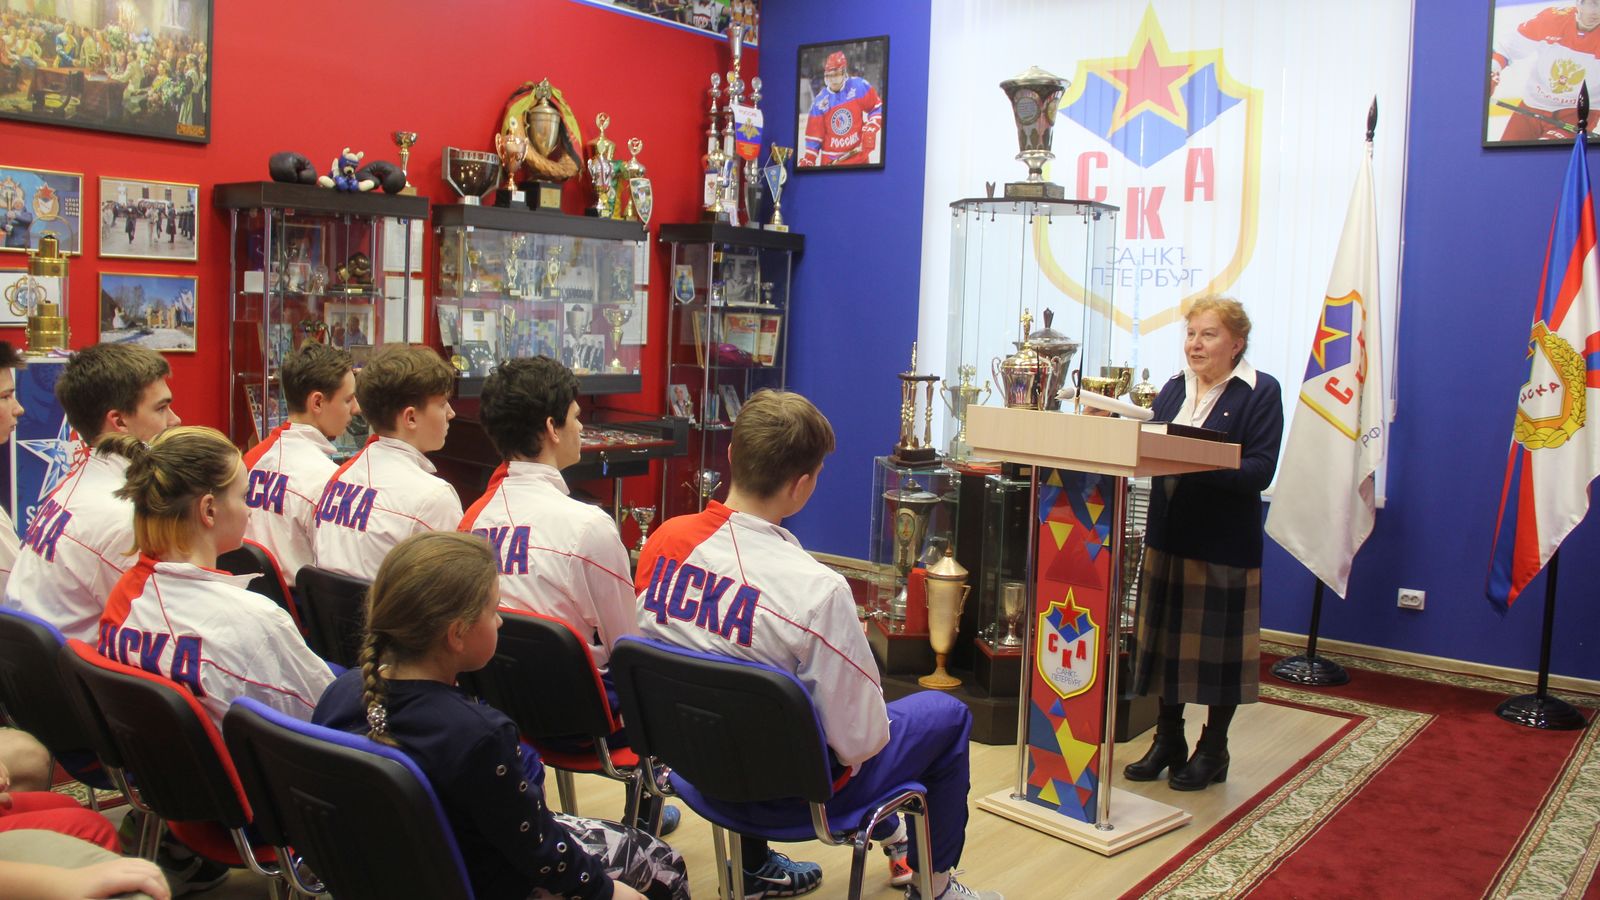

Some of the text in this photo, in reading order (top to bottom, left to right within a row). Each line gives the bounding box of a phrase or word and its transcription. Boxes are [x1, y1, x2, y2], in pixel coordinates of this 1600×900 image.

[1076, 147, 1215, 240] СКА
[246, 469, 290, 517] СКА
[644, 555, 761, 648] ЦСКА
[1047, 632, 1087, 669] СКА
